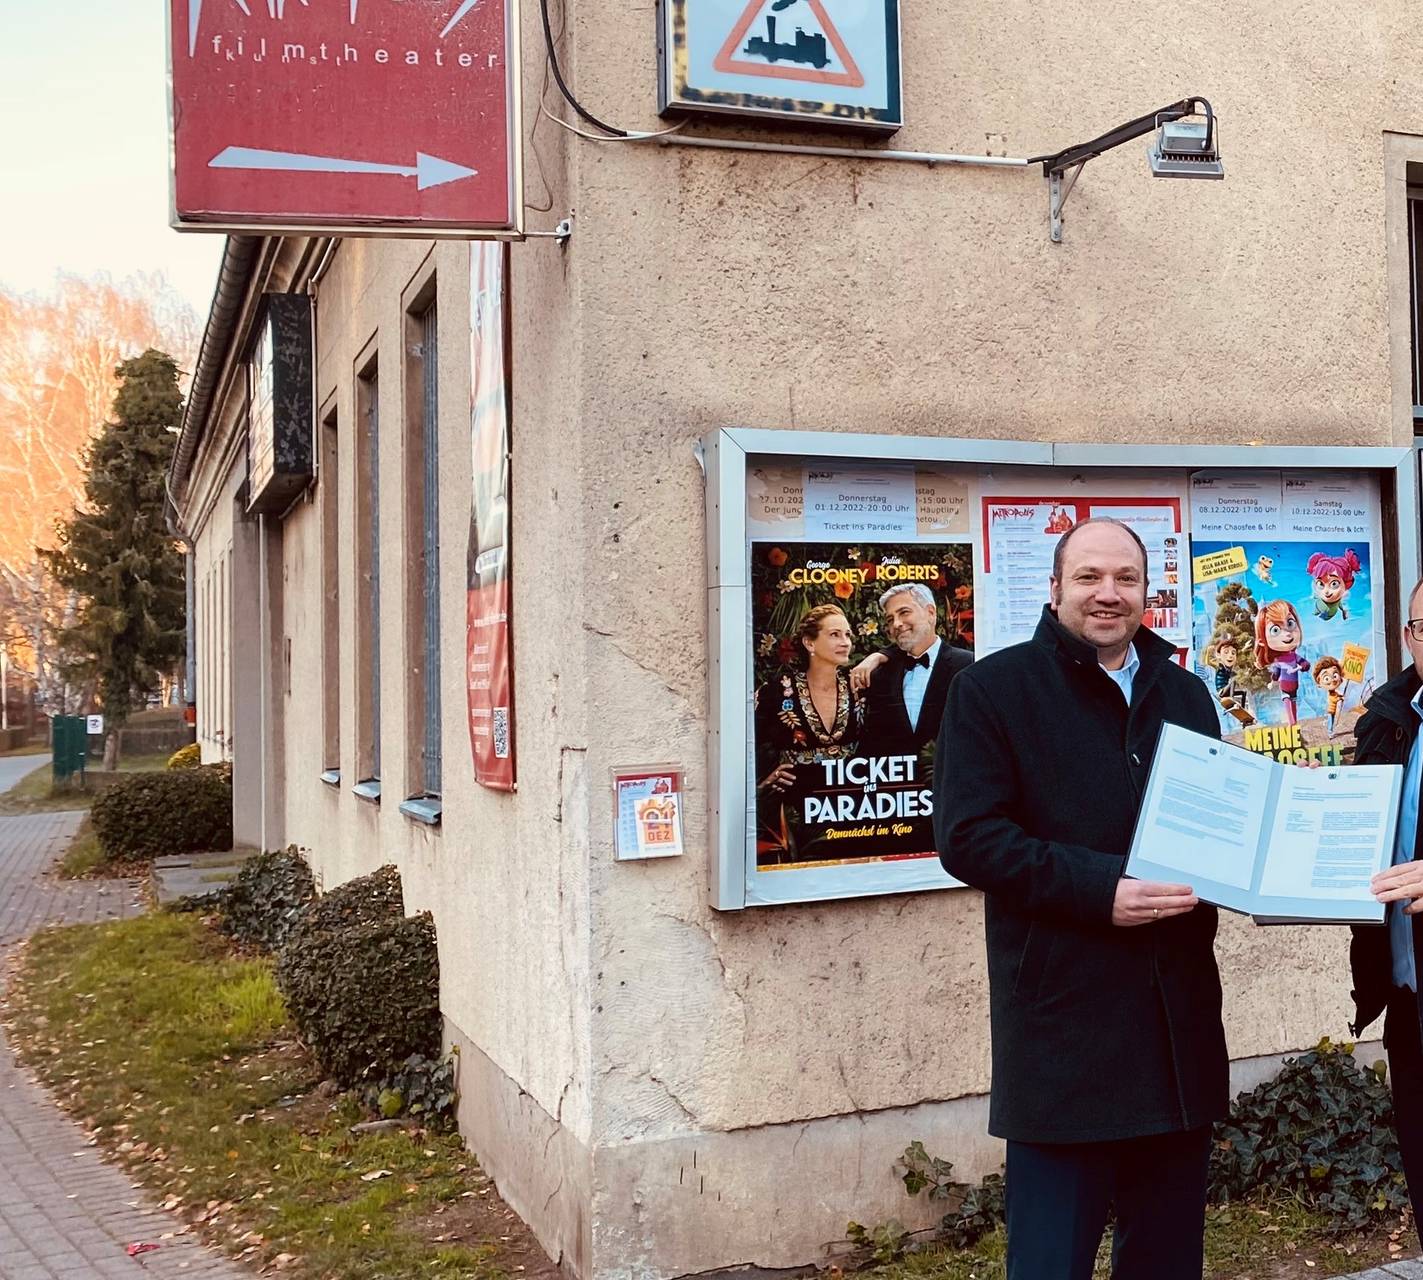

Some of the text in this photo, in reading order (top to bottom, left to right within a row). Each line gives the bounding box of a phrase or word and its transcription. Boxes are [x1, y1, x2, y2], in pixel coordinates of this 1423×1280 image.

[212, 35, 498, 67] filmtheater
[838, 494, 887, 504] Donnerstag
[1217, 498, 1258, 506] Donnerstag
[1313, 500, 1343, 509] Samstag
[764, 505, 781, 514] Der
[814, 503, 892, 512] 01.12.2022-20:00
[824, 522, 849, 531] Ticket
[867, 523, 903, 531] Paradies
[1224, 524, 1256, 532] Chaosfee
[1265, 523, 1277, 531] Ich
[1353, 525, 1365, 533] Ich
[806, 560, 831, 570] George
[881, 556, 901, 567] Julia
[789, 568, 869, 584] CLOONEY
[876, 564, 939, 580] ROBERTS
[1344, 657, 1363, 675] KINO
[1245, 724, 1302, 751] MEINE
[821, 755, 918, 786] TICKET
[863, 782, 877, 793] ins
[804, 789, 934, 824] PARADIES
[647, 831, 671, 842] DEZ
[825, 822, 914, 840] Demnächst im Kino
